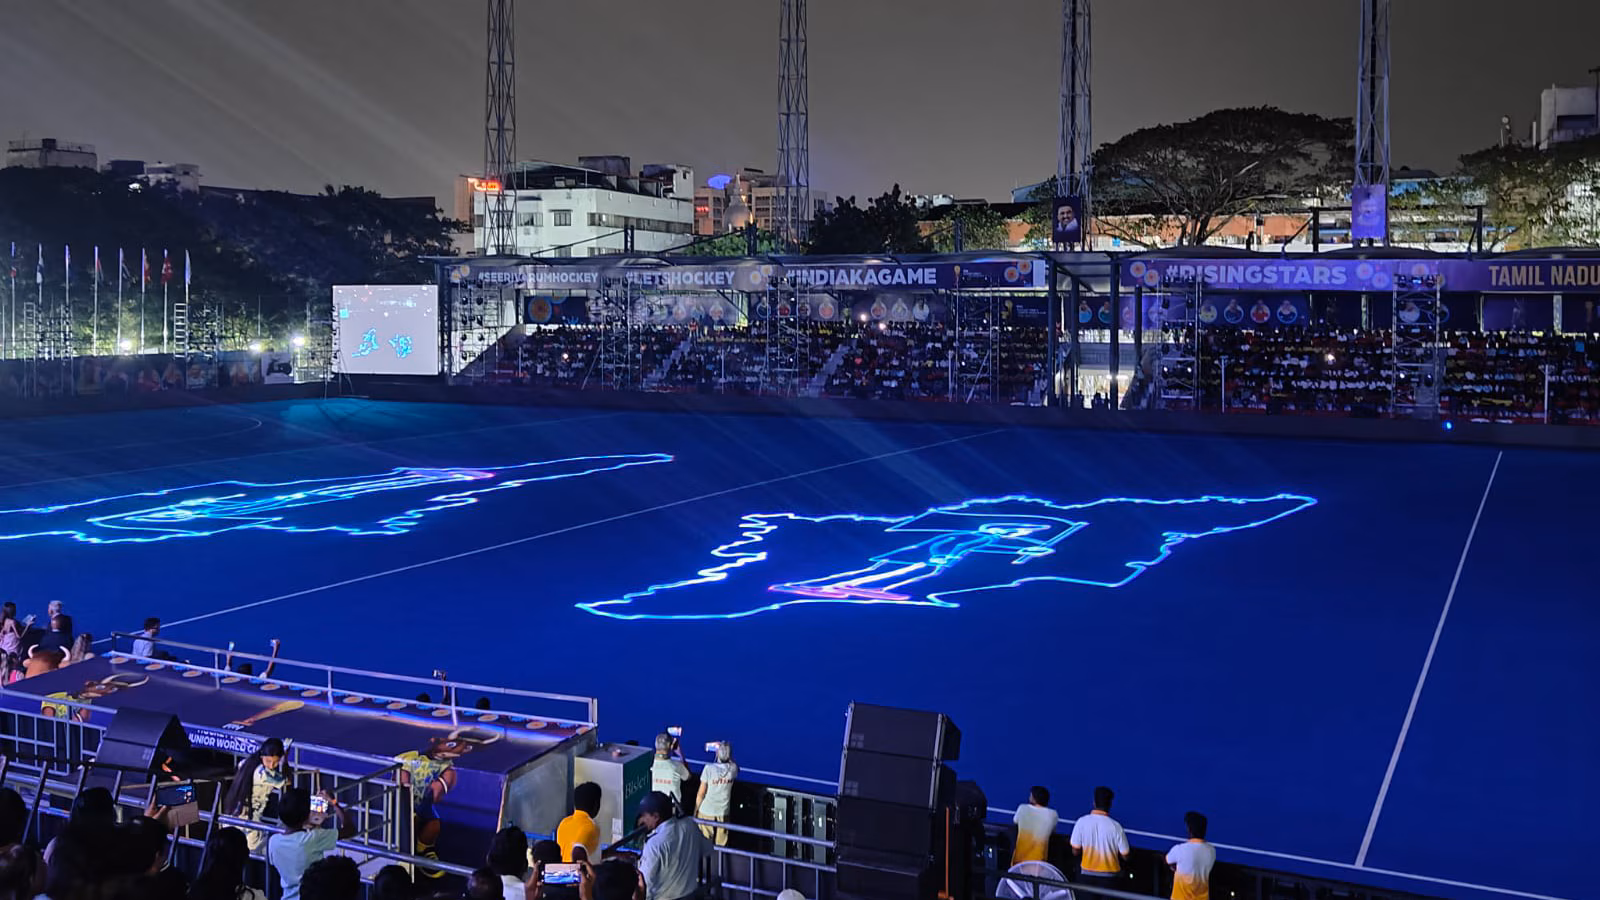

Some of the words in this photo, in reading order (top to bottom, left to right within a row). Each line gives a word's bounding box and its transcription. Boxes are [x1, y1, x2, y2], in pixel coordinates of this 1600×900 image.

[626, 271, 735, 285] #LETSHOCKEY
[786, 268, 937, 285] #INDIAKAGAME
[1488, 265, 1545, 287] TAMIL
[1551, 265, 1600, 287] NADU
[216, 737, 246, 752] WORLD
